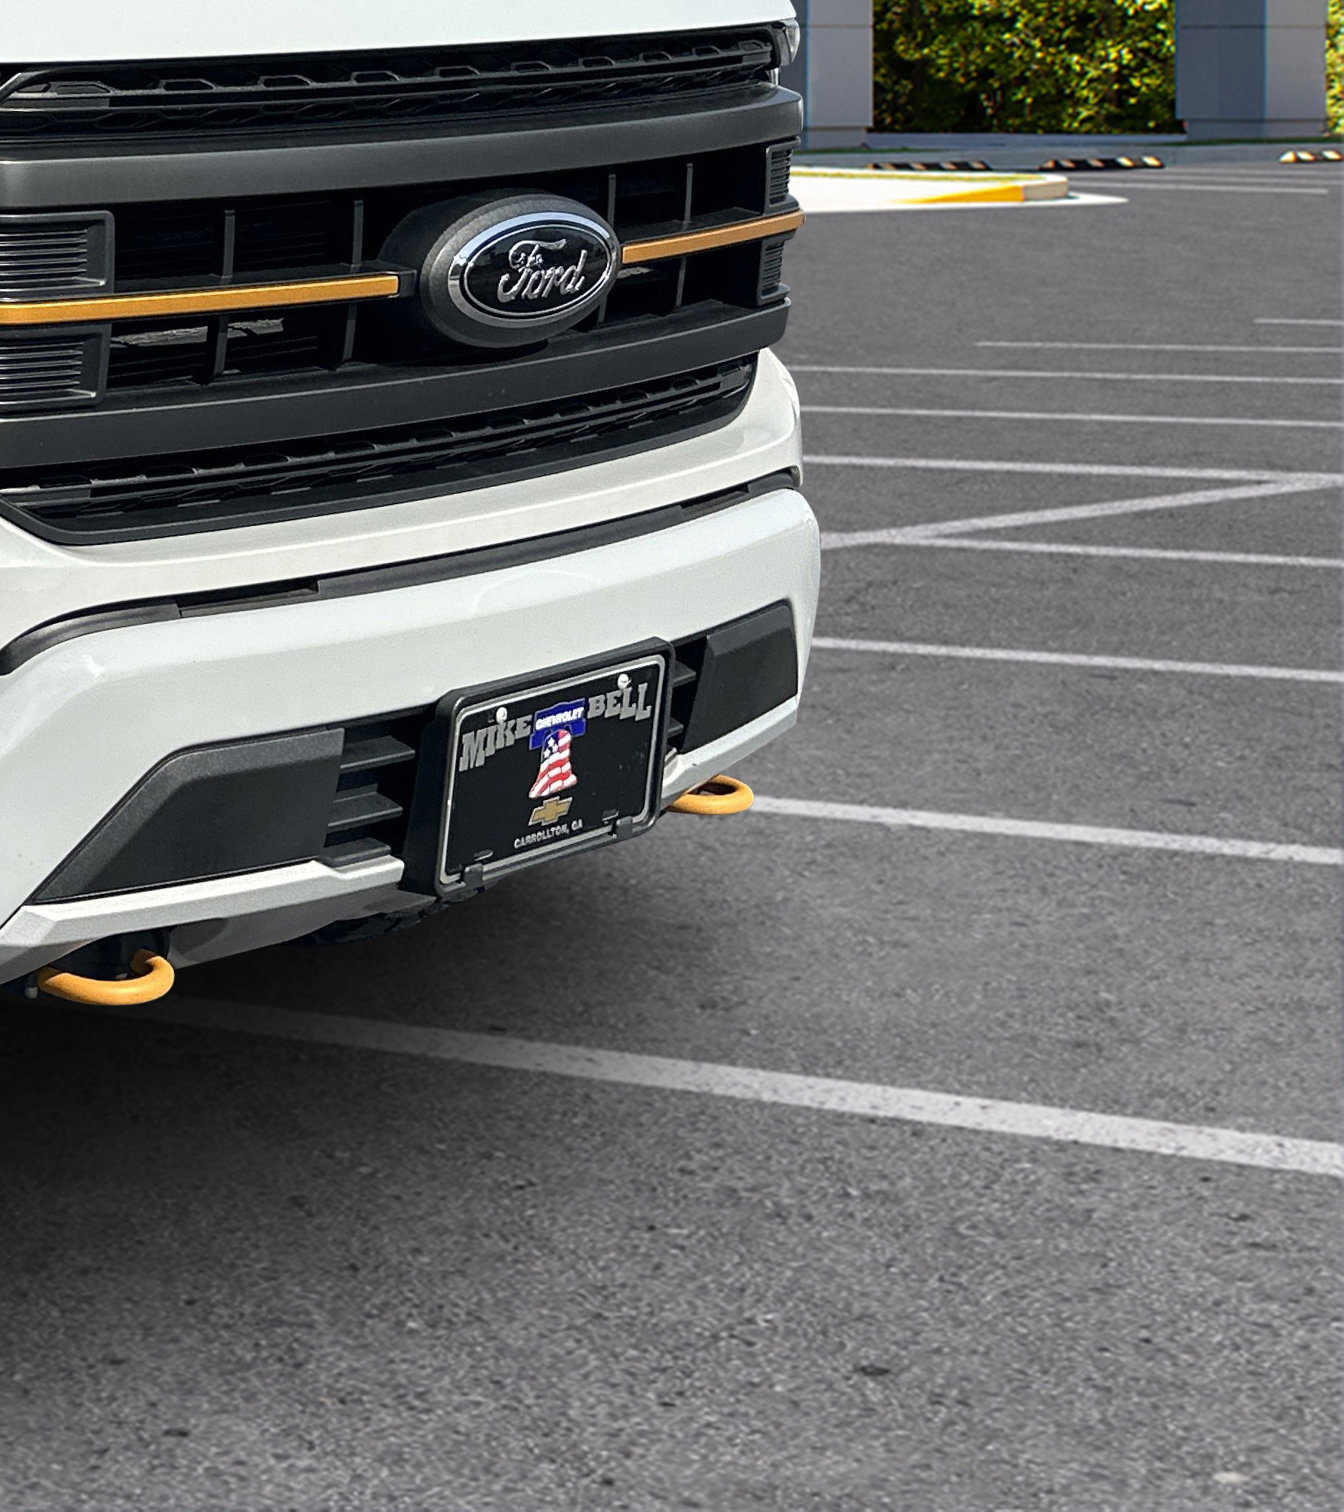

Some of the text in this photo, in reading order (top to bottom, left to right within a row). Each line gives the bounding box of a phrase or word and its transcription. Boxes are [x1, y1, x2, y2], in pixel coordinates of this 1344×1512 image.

[497, 238, 587, 304] Ford
[459, 682, 653, 773] MIKE BELL
